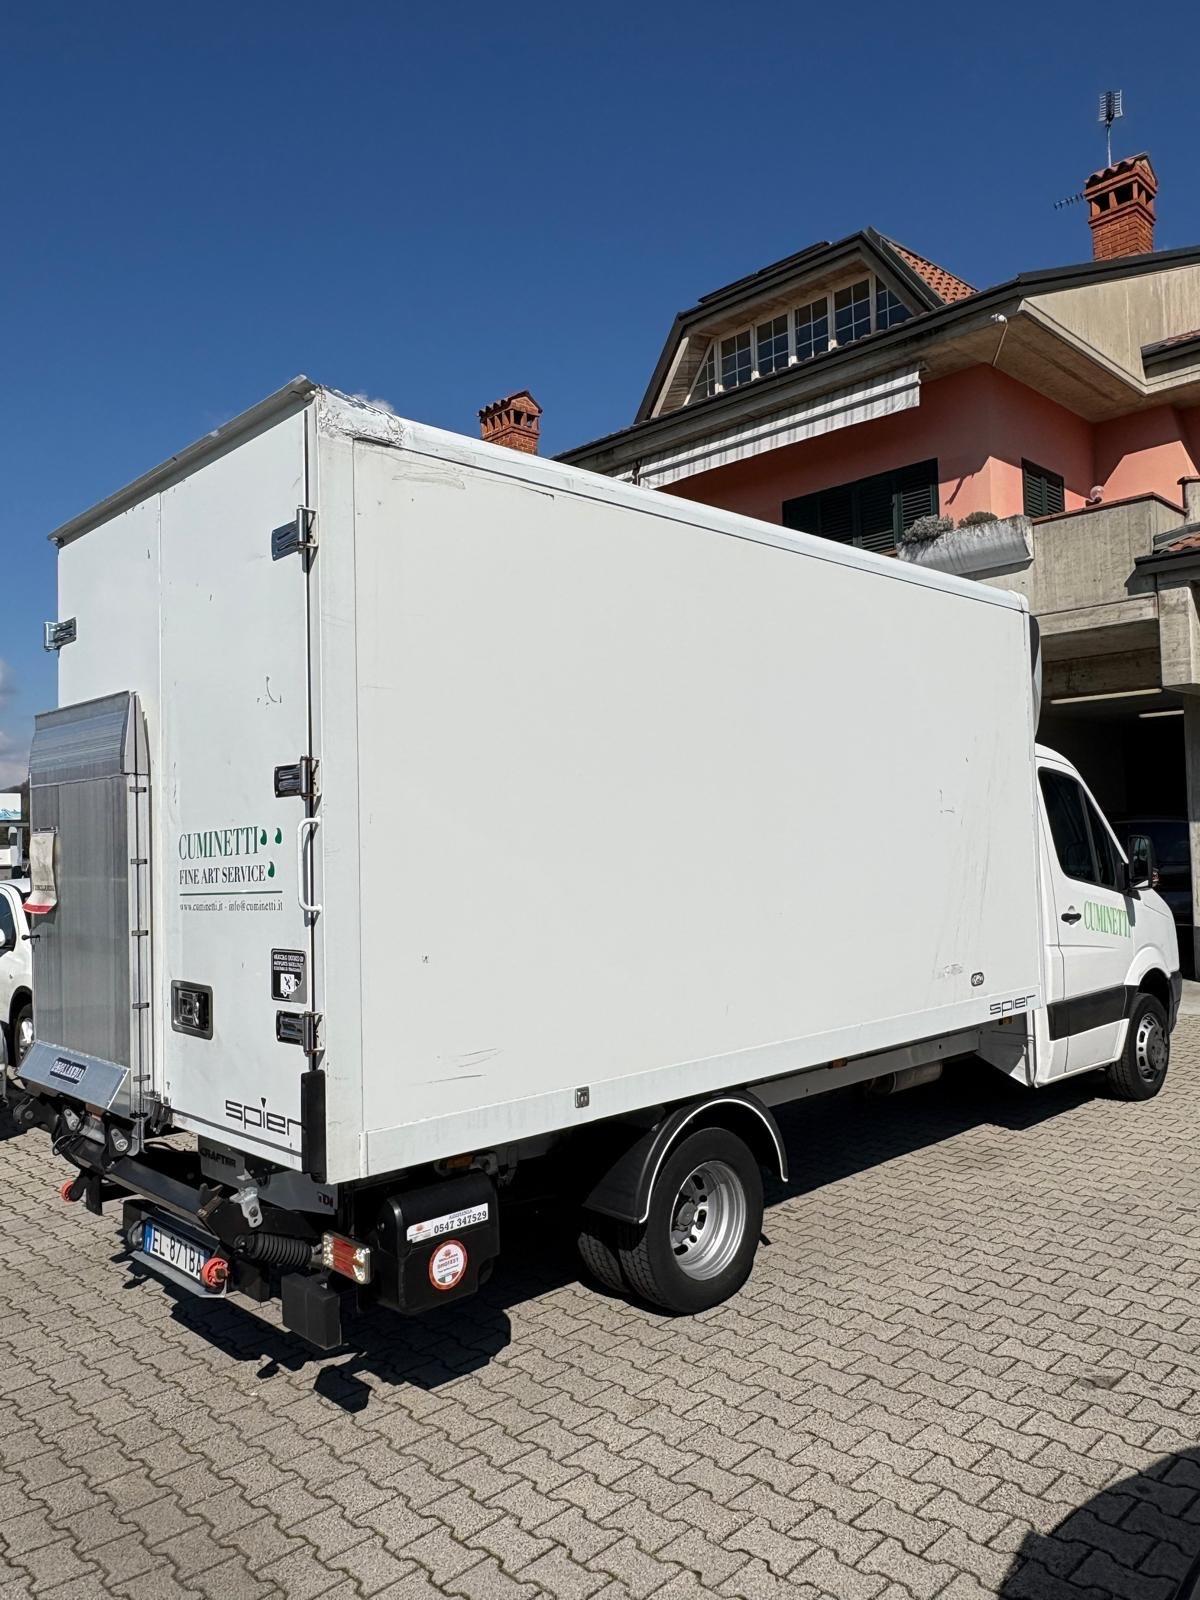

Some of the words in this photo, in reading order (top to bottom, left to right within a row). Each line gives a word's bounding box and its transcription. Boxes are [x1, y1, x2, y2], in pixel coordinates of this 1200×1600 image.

[178, 826, 259, 860] CUMINETTI
[179, 869, 200, 885] FINE
[200, 867, 220, 884] ART
[221, 864, 266, 883] SERVICE
[989, 994, 1036, 1016] spier
[225, 1097, 304, 1136] spier
[433, 1220, 455, 1234] 0547
[456, 1210, 487, 1227] 347529
